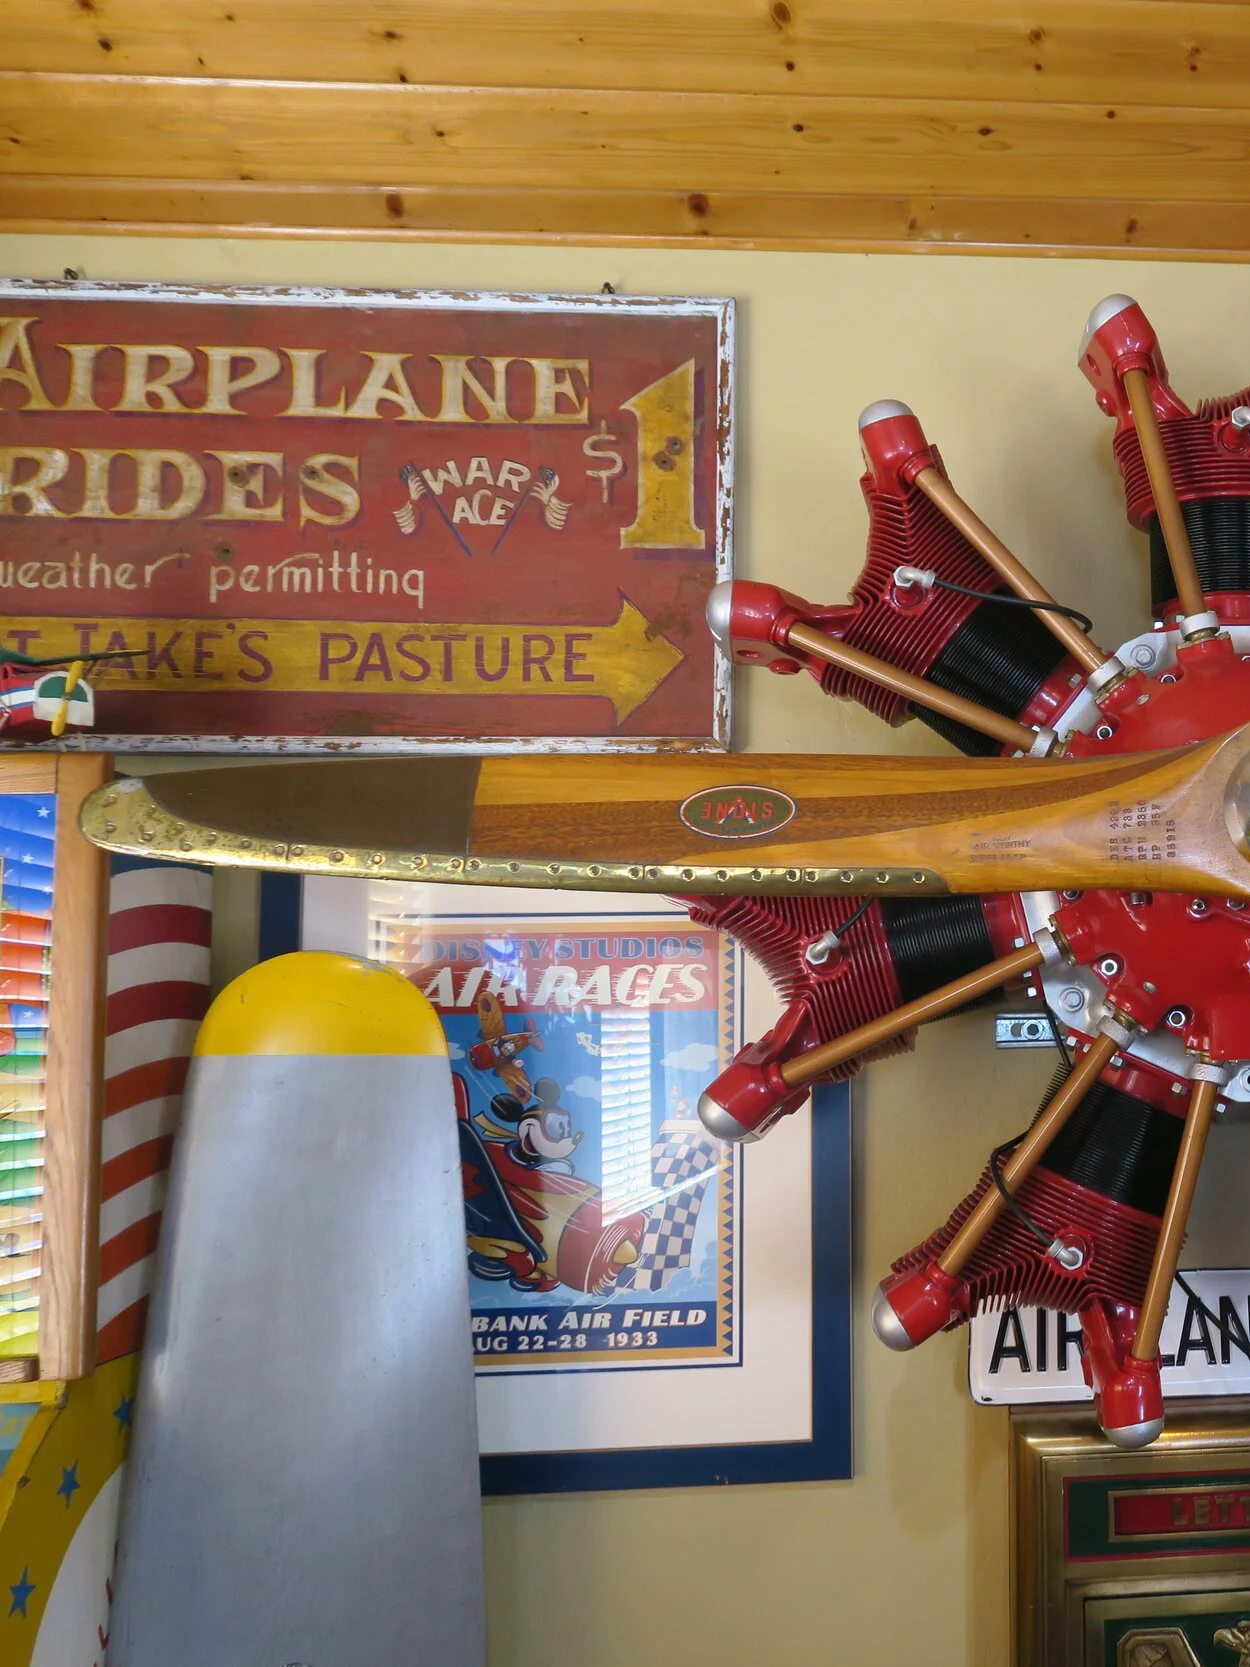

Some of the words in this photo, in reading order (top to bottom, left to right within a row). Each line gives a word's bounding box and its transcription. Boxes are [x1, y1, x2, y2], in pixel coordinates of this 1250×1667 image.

[0, 316, 589, 424] AIRPLANE
[0, 446, 361, 527] RIDES
[421, 456, 531, 496] WAR
[452, 488, 514, 526] ACE
[210, 550, 425, 609] permitting
[318, 632, 596, 682] PASTURE
[699, 801, 776, 819] STONE
[554, 936, 705, 960] STUDIOS
[423, 964, 520, 1008] AIR
[531, 962, 709, 1008] RACES
[471, 1314, 549, 1333] BANK
[557, 1310, 613, 1330] AIR
[622, 1308, 708, 1328] FIELD
[472, 1336, 508, 1351] UG
[517, 1333, 588, 1350] 22-28
[606, 1331, 659, 1348] 1933
